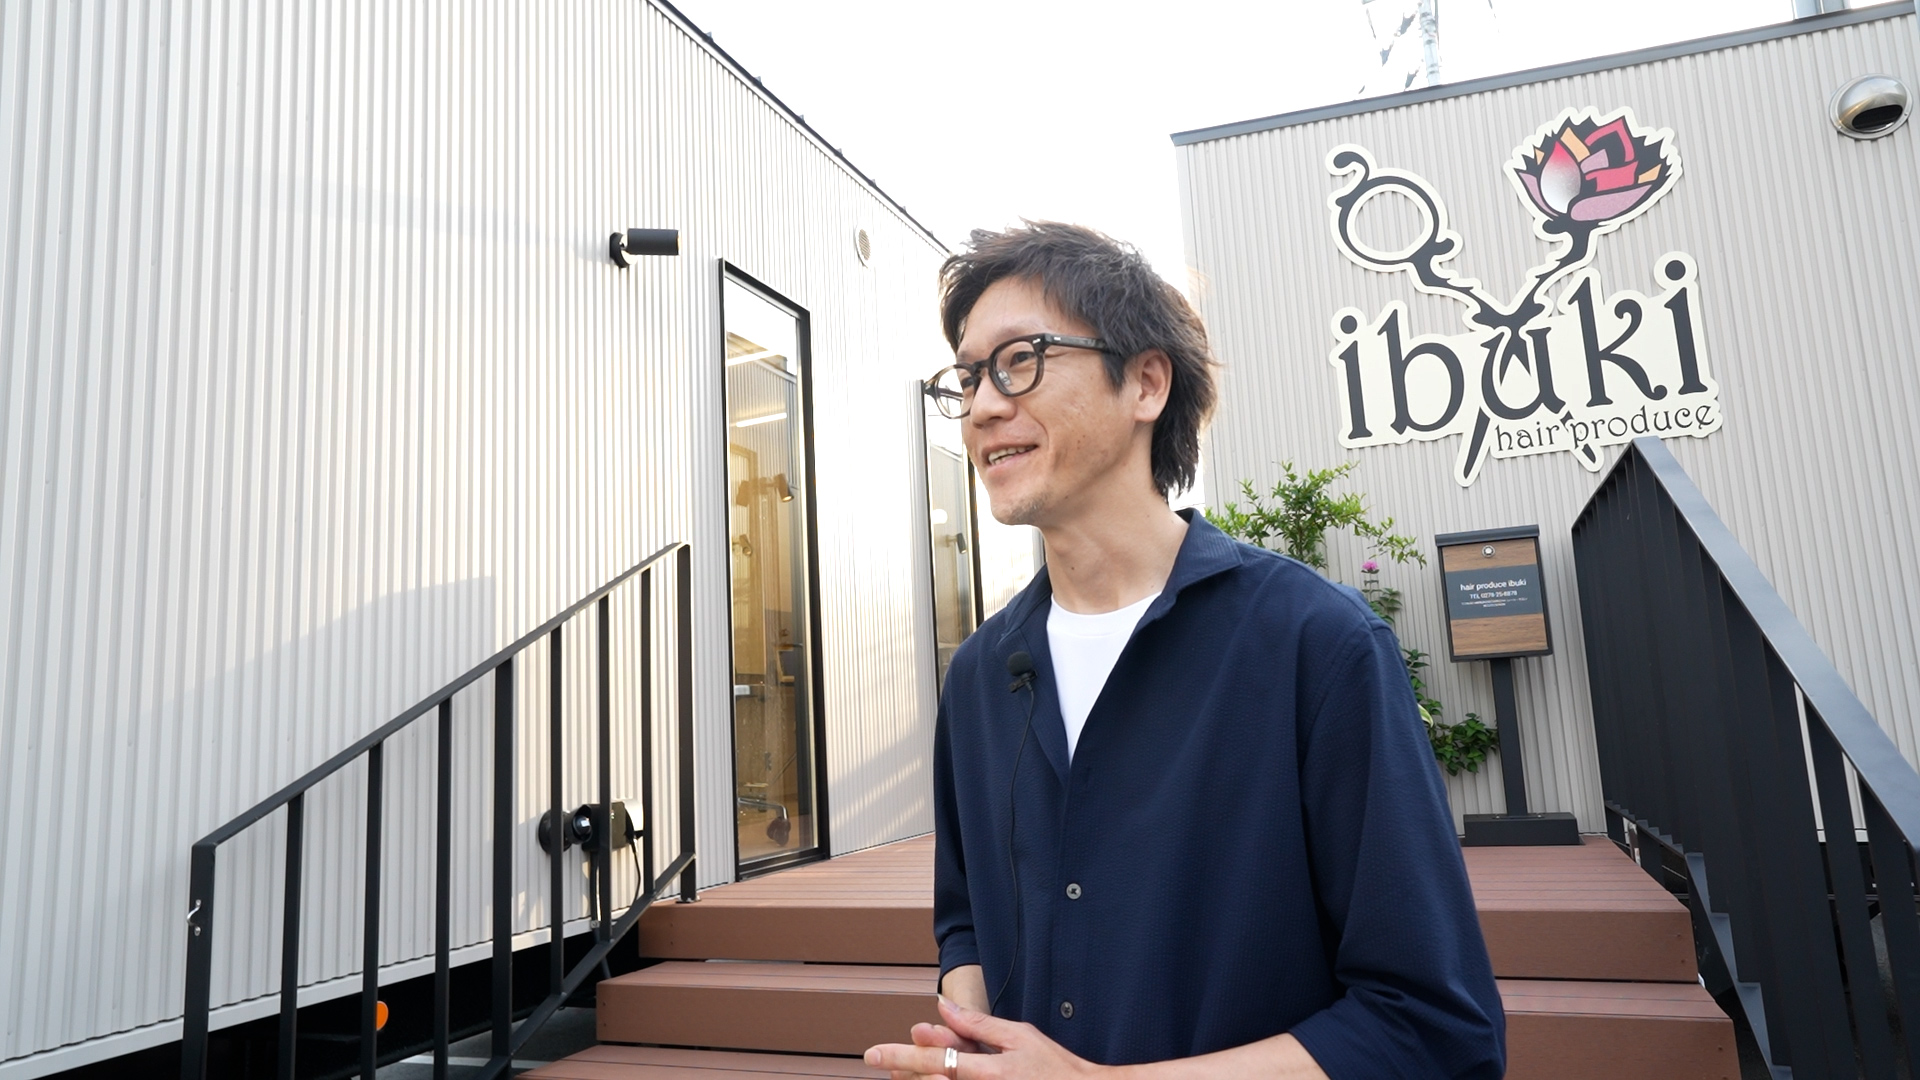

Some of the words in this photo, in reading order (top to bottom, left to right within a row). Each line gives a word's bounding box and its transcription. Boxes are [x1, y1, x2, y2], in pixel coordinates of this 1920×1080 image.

[1338, 259, 1708, 440] ibuki
[1495, 420, 1560, 451] hair
[1570, 404, 1715, 449] produce
[1460, 583, 1475, 591] hair
[1476, 581, 1507, 591] produce
[1508, 578, 1527, 587] ibuki
